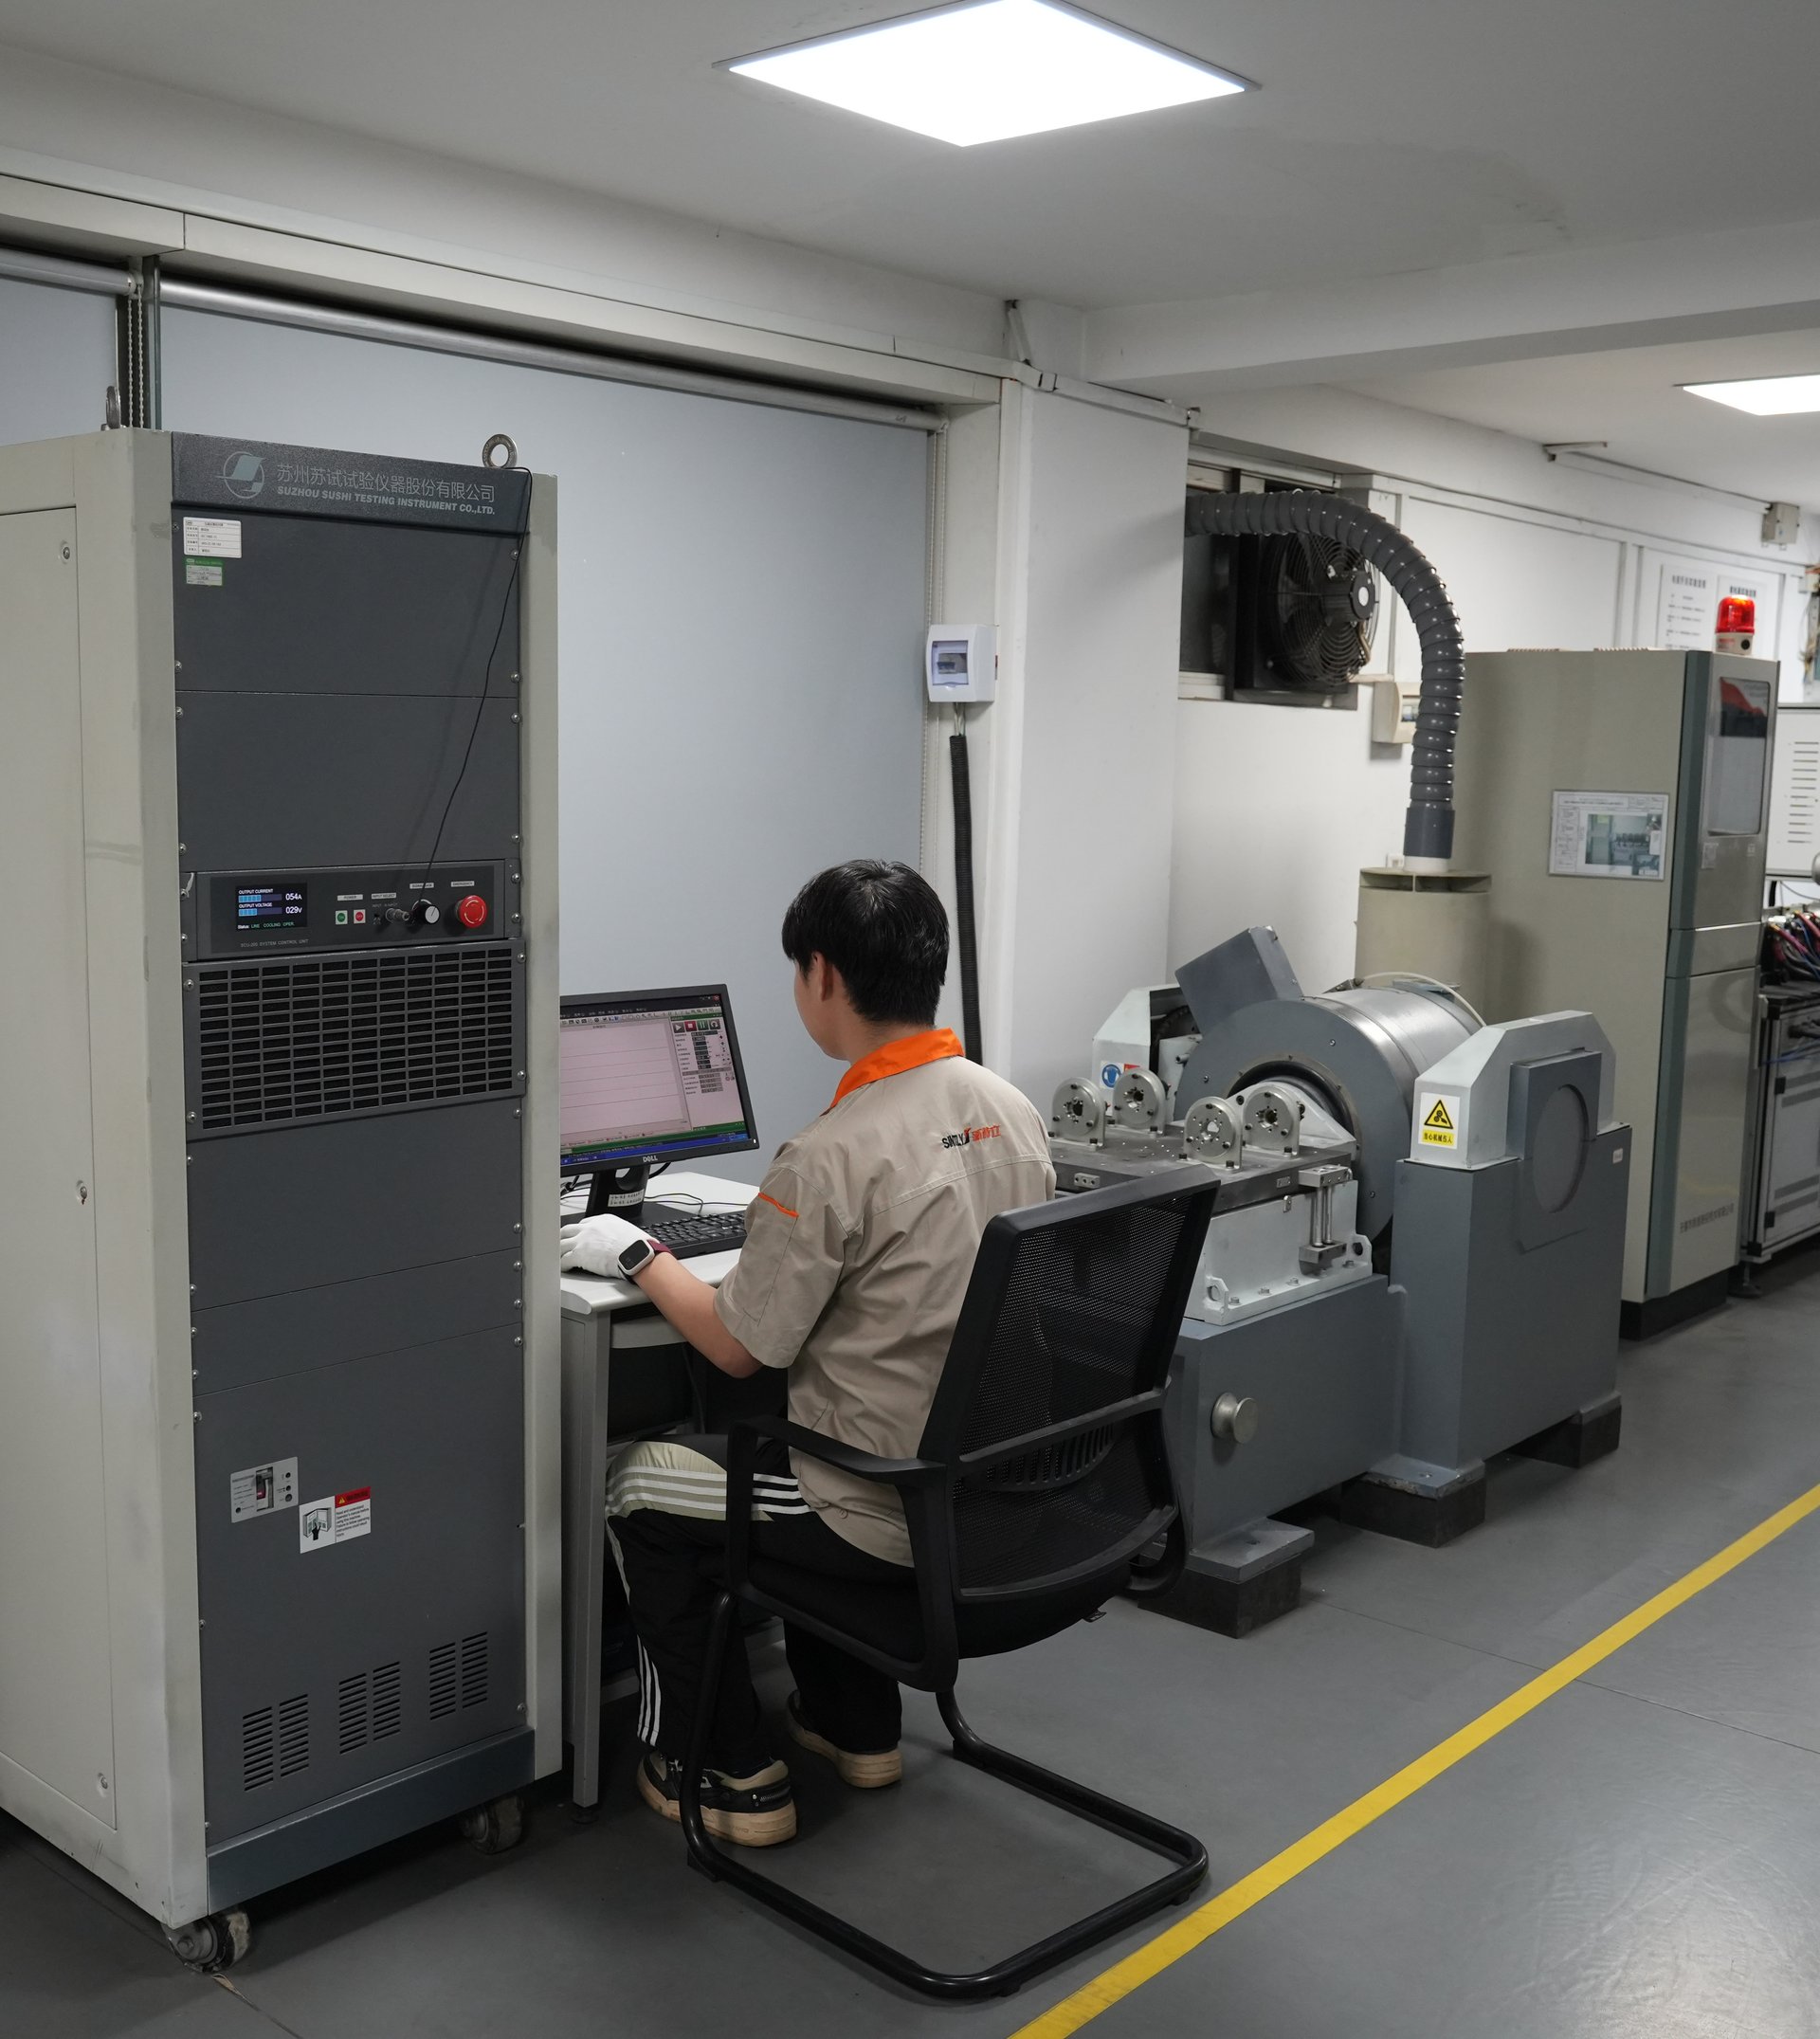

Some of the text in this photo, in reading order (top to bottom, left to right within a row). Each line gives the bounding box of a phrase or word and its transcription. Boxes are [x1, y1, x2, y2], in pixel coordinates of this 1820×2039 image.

[277, 464, 495, 503] 苏州苏试试验仪器股份有限公司
[277, 486, 320, 499] SUZHOU
[321, 490, 352, 501] SUSHI
[355, 493, 395, 506] TESTING
[397, 498, 457, 512] INSTRUMENT
